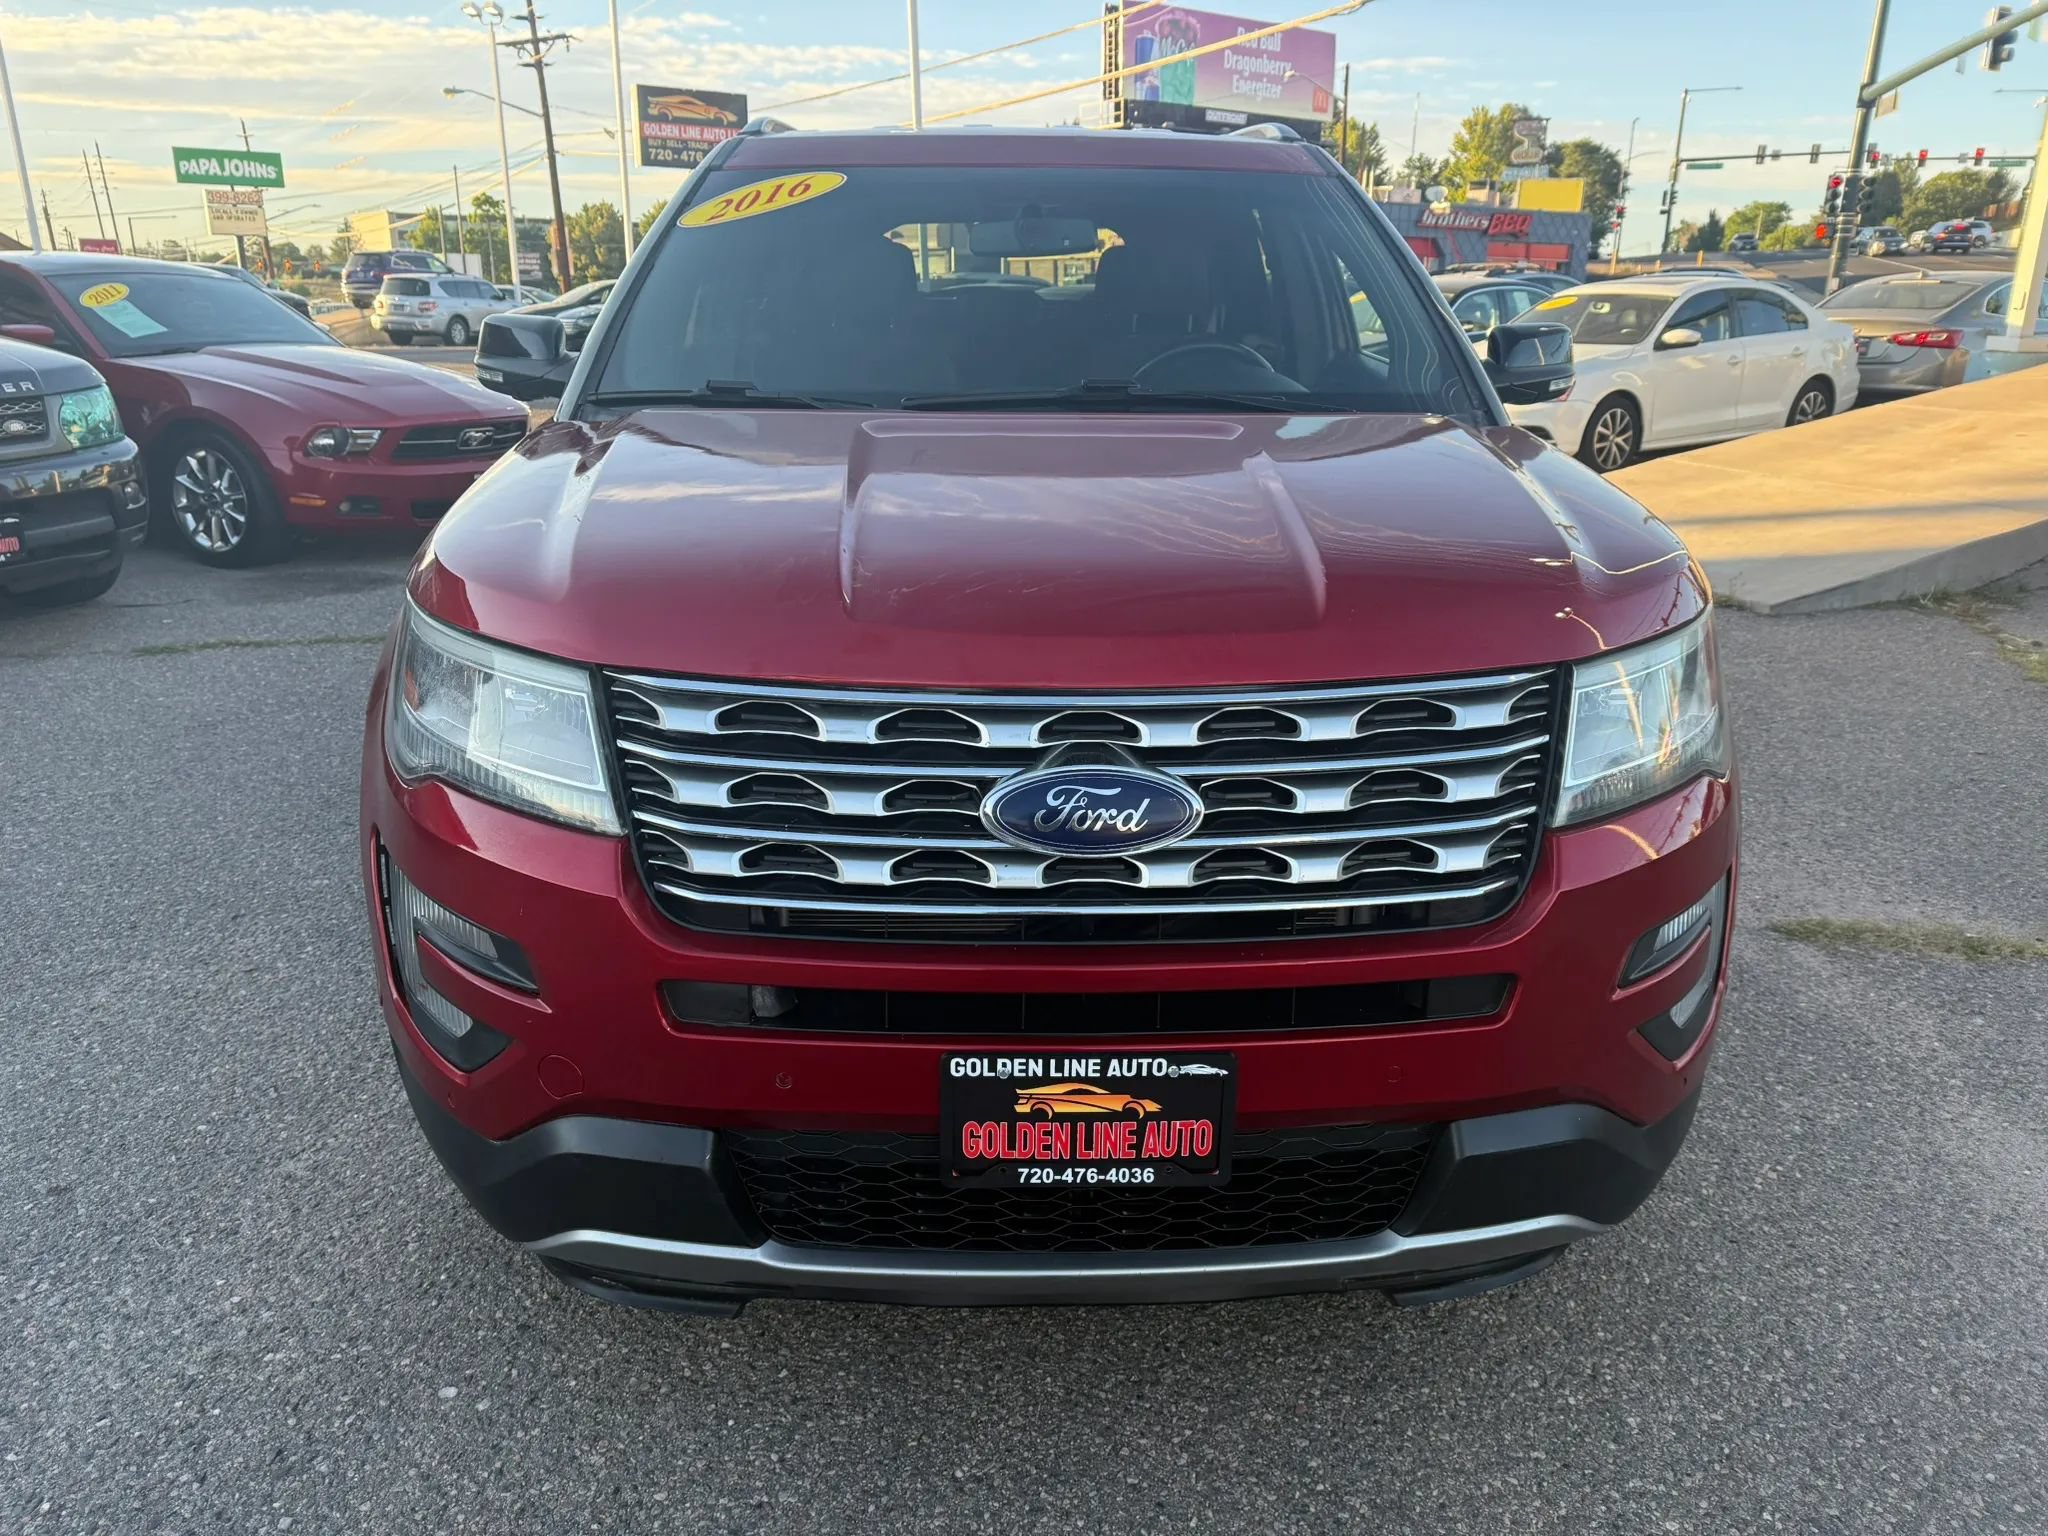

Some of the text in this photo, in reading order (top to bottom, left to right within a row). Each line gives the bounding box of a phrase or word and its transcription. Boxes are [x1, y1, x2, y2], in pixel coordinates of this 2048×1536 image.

[1224, 49, 1292, 77] Dragonberry
[1232, 74, 1282, 101] Energizer
[643, 122, 679, 138] GOLDEN
[680, 126, 702, 139] LINE
[703, 129, 726, 141] AUTO
[178, 157, 277, 179] PAPA JOHNS
[704, 174, 818, 222] 2016
[88, 284, 124, 305] 2011
[1034, 785, 1150, 833] Ford
[950, 1057, 1168, 1078] GOLDEN LINE AUTO
[962, 1119, 1213, 1160] GOLDEN LINE AUTO
[1017, 1167, 1155, 1184] 720-476-4036
